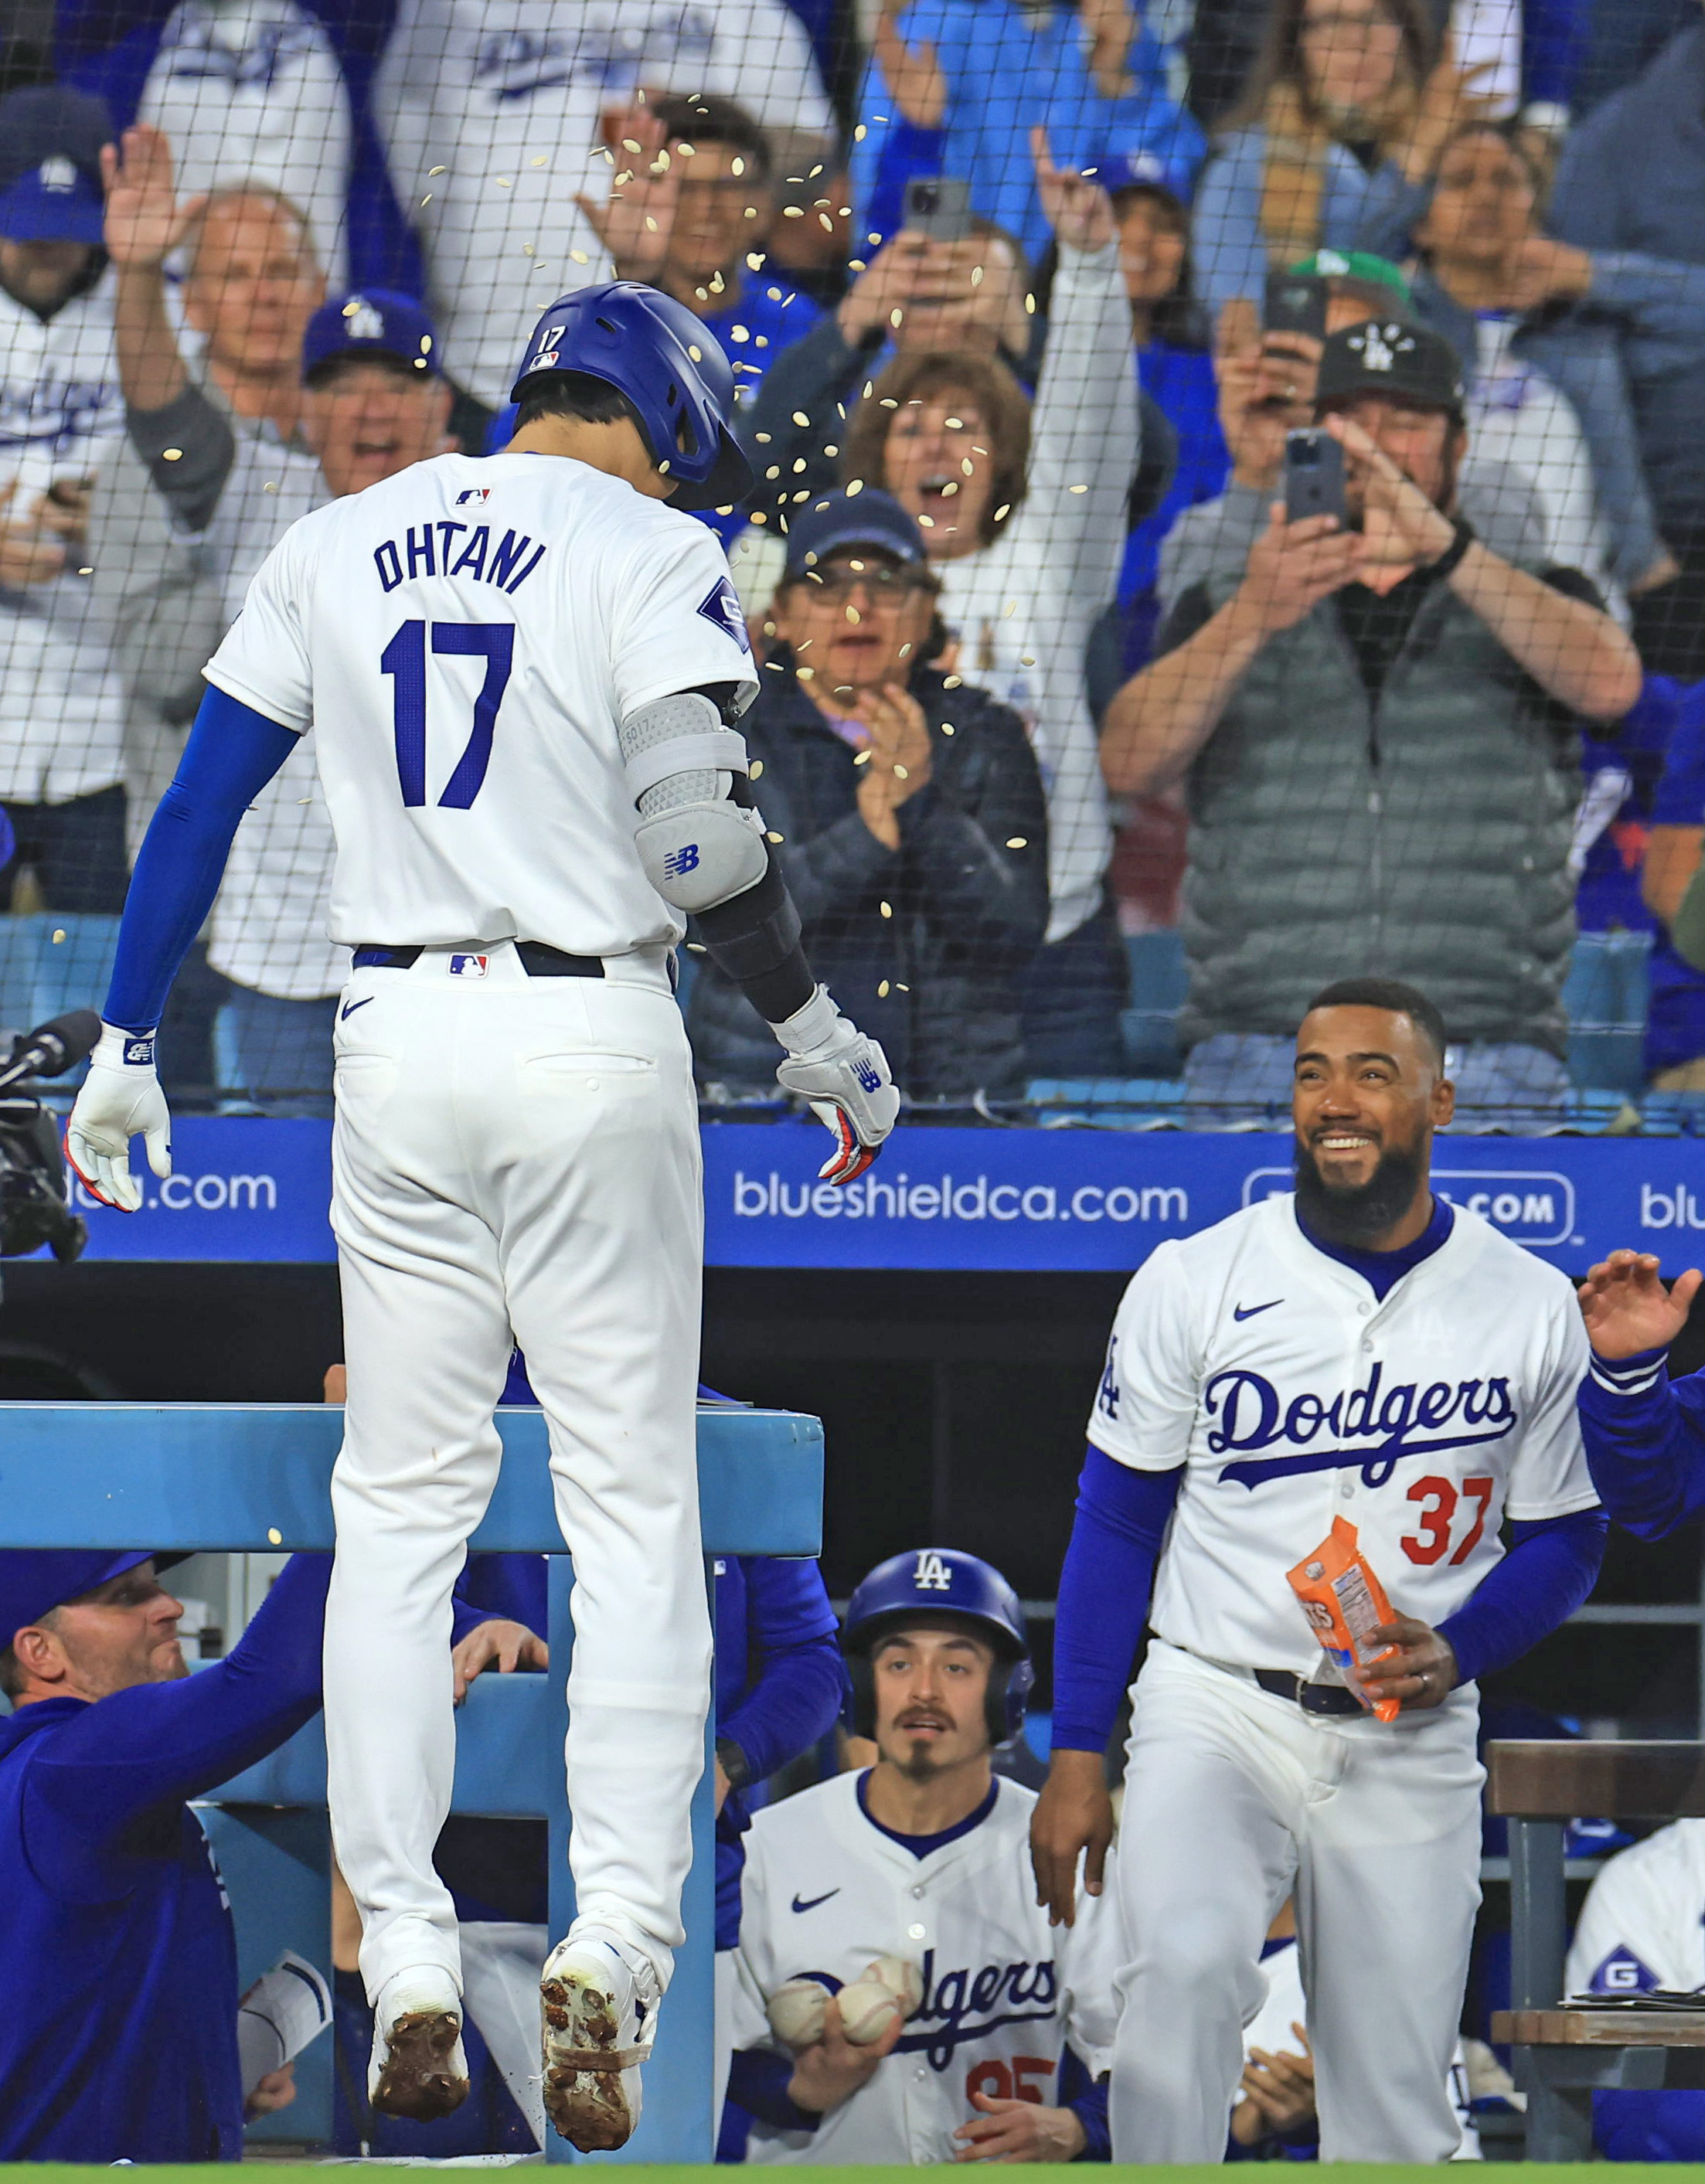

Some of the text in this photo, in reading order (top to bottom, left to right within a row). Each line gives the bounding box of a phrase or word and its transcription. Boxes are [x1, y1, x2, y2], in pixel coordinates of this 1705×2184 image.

[538, 325, 567, 353] 17
[373, 521, 546, 595] OHTANI
[380, 619, 516, 810] 17
[733, 1172, 1188, 1221] blueshieldca.com
[1205, 1361, 1517, 1488] Dodgers
[1400, 1475, 1493, 1566] 37
[913, 1549, 952, 1590] LA
[1605, 1961, 1639, 1988] G
